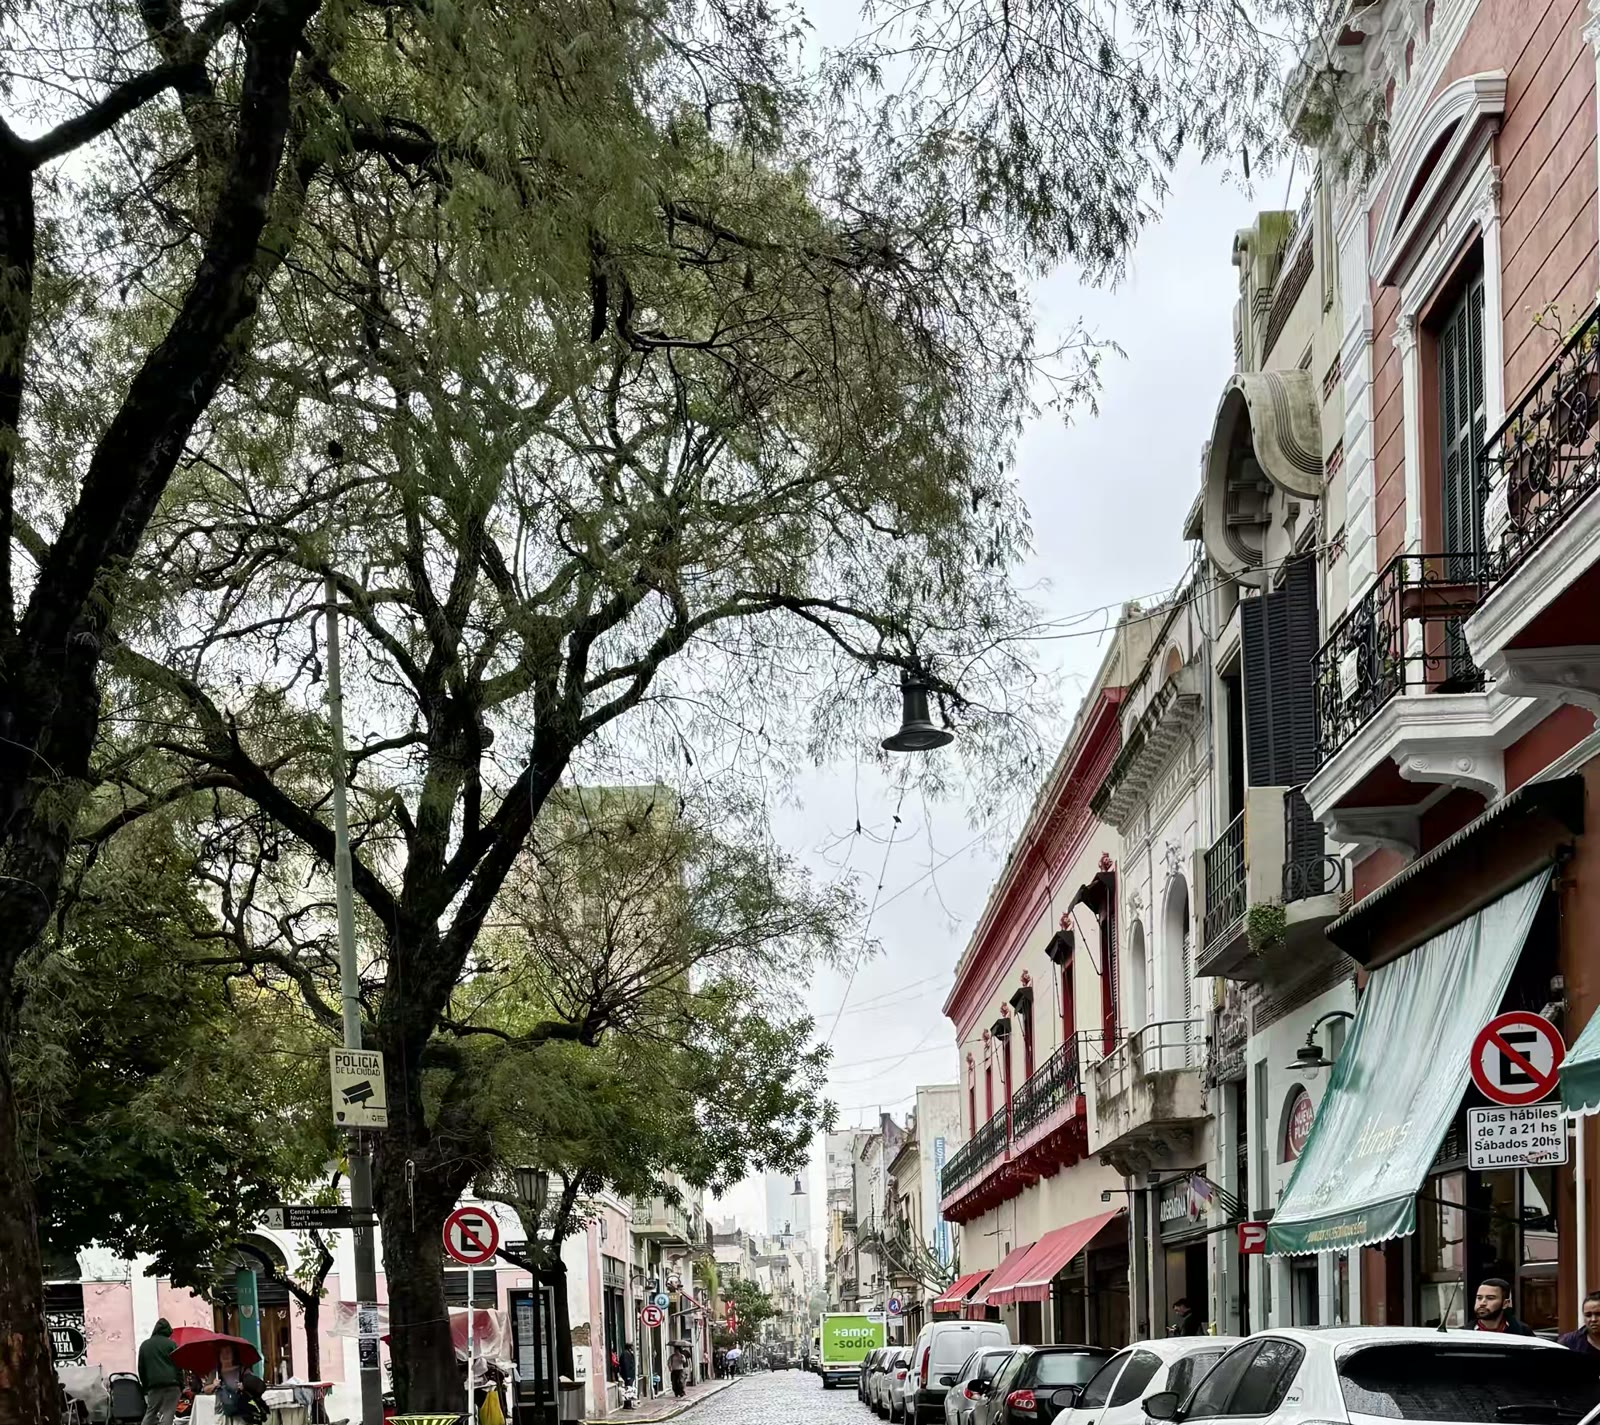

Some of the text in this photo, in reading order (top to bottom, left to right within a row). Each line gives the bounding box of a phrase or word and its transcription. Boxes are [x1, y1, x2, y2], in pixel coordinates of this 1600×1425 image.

[335, 1055, 380, 1069] POLICIA
[347, 1067, 356, 1075] LA
[356, 1068, 381, 1077] CIUDAD
[1476, 1108, 1558, 1123] Días hábiles
[1478, 1122, 1557, 1137] de 7 a 21 hs
[1474, 1136, 1562, 1151] Sábados 20hs
[1477, 1156, 1484, 1165] a
[1488, 1152, 1525, 1164] Lunes
[52, 1331, 71, 1342] VACA
[832, 1328, 876, 1337] +amor
[833, 1336, 875, 1349] -sodio
